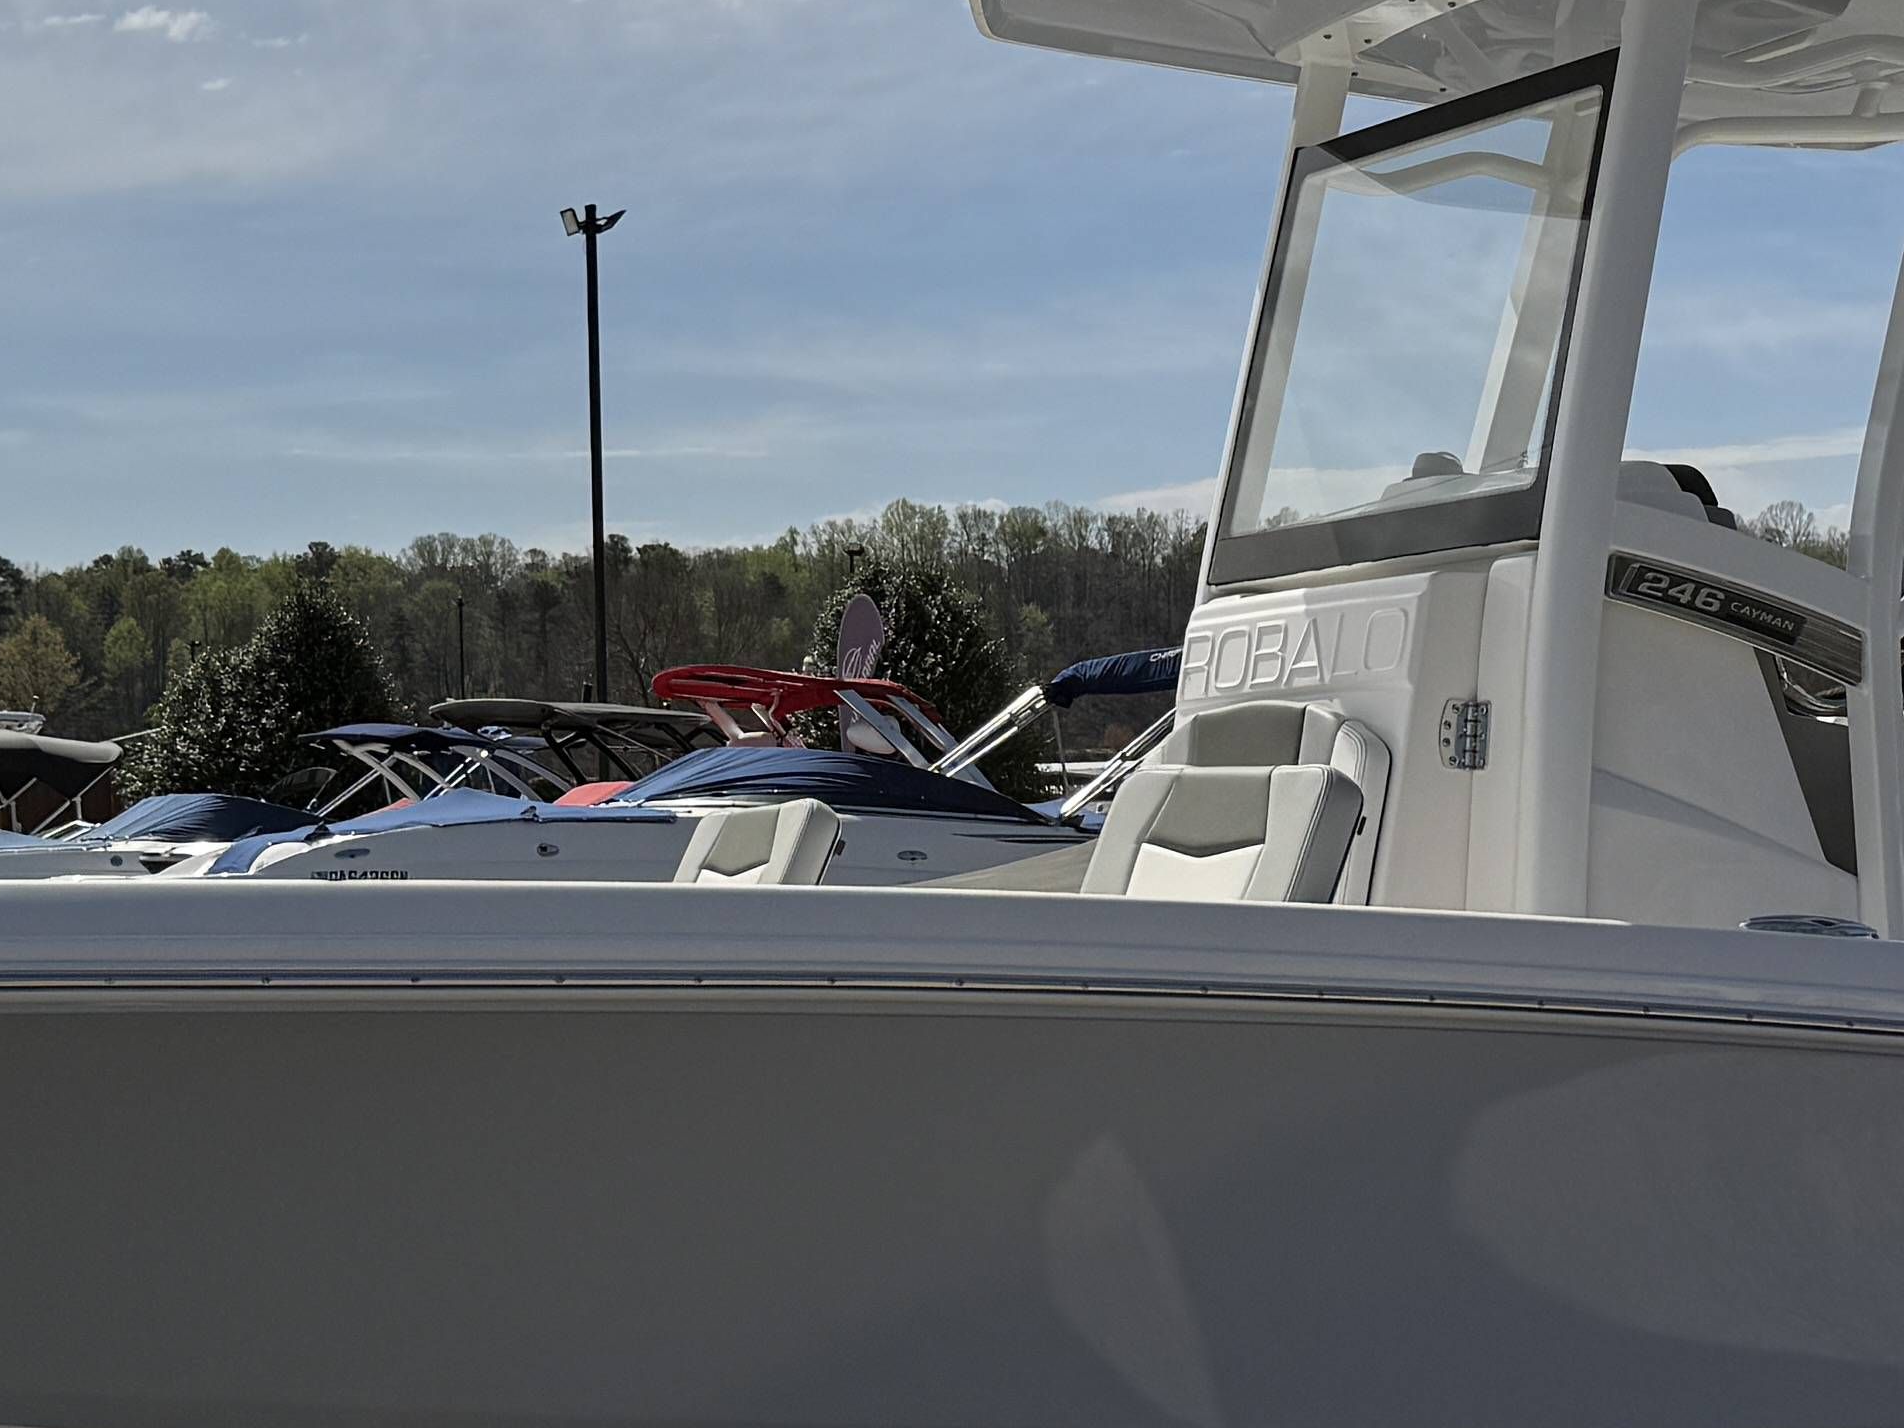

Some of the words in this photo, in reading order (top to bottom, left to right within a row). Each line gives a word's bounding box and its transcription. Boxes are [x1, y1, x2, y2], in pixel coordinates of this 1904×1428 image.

[1637, 572, 1725, 613] 246
[1730, 602, 1795, 632] CAYMAN
[1181, 607, 1409, 700] ROBALO
